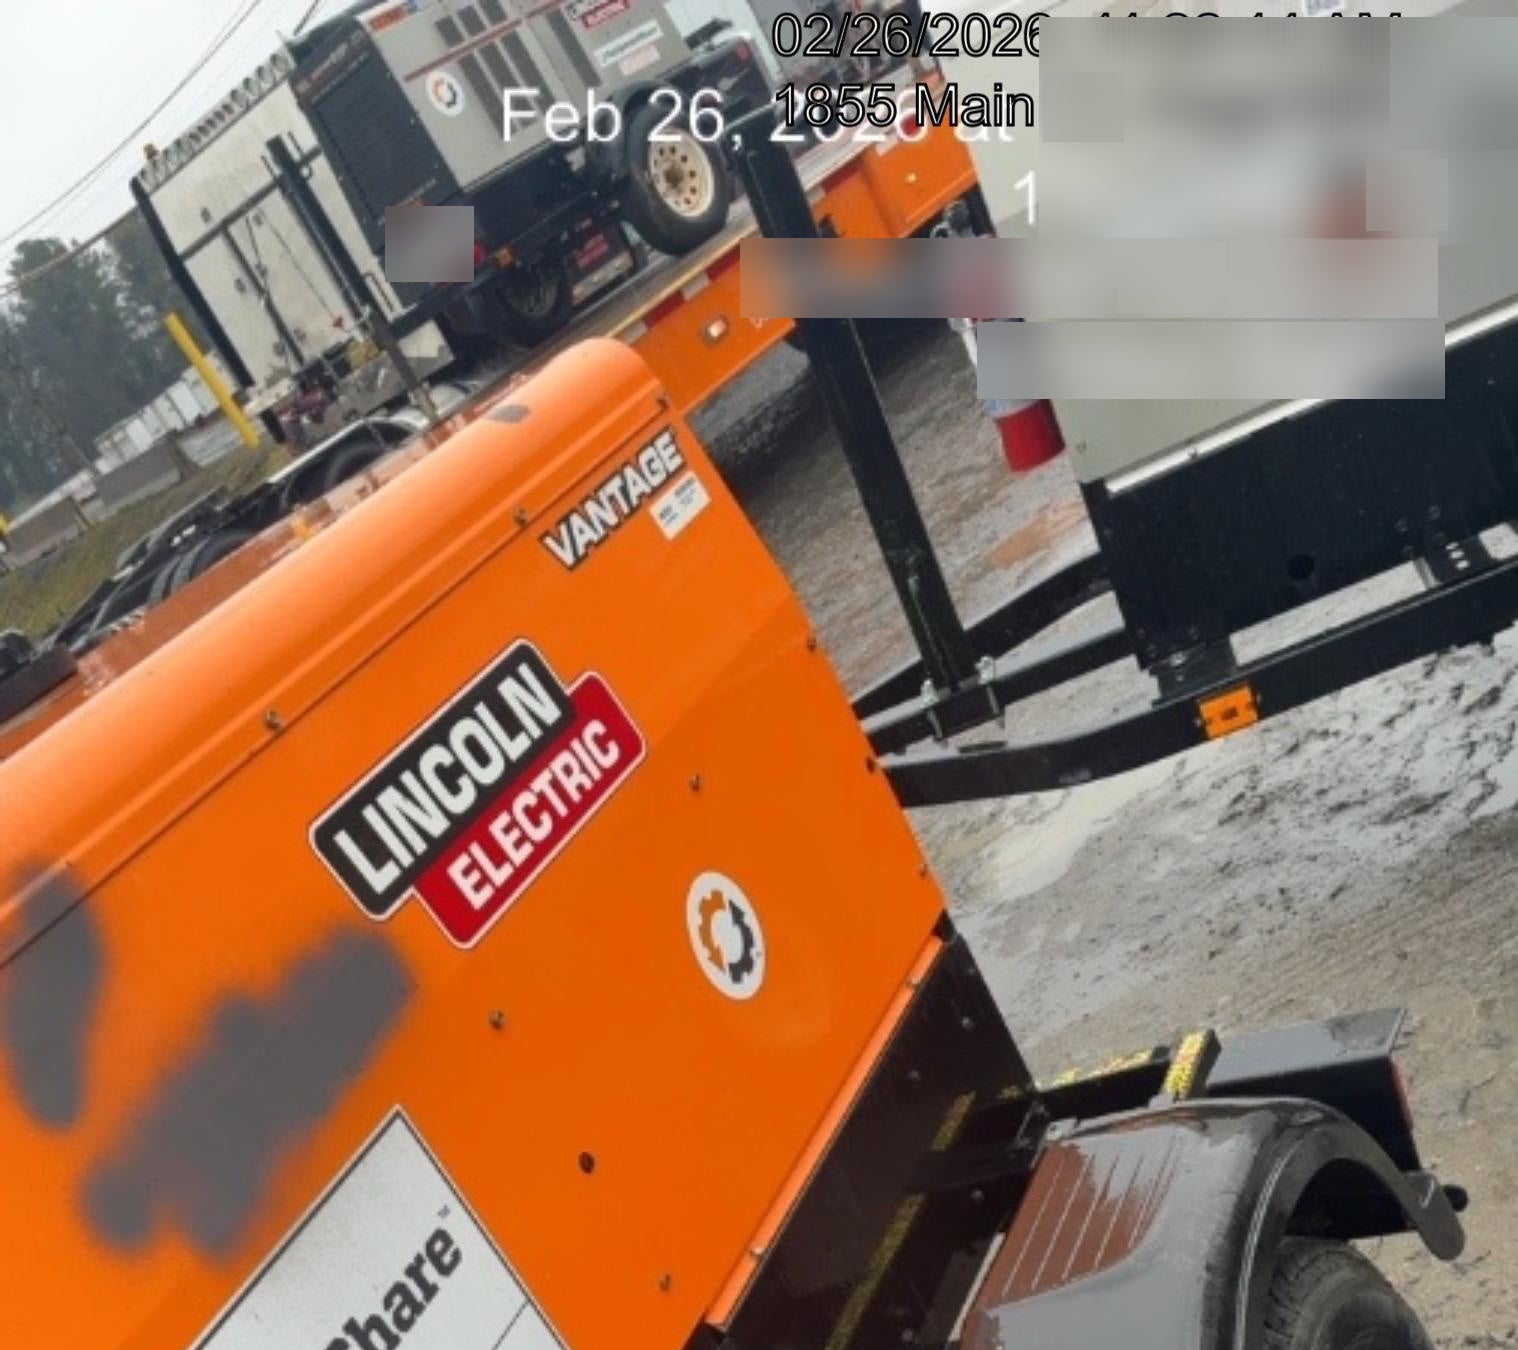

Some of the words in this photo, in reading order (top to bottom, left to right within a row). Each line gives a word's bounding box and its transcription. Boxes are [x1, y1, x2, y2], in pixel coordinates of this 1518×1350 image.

[541, 427, 685, 571] VANTAGE
[333, 662, 565, 896] LINCOLN
[446, 717, 621, 911] ELECTRIC
